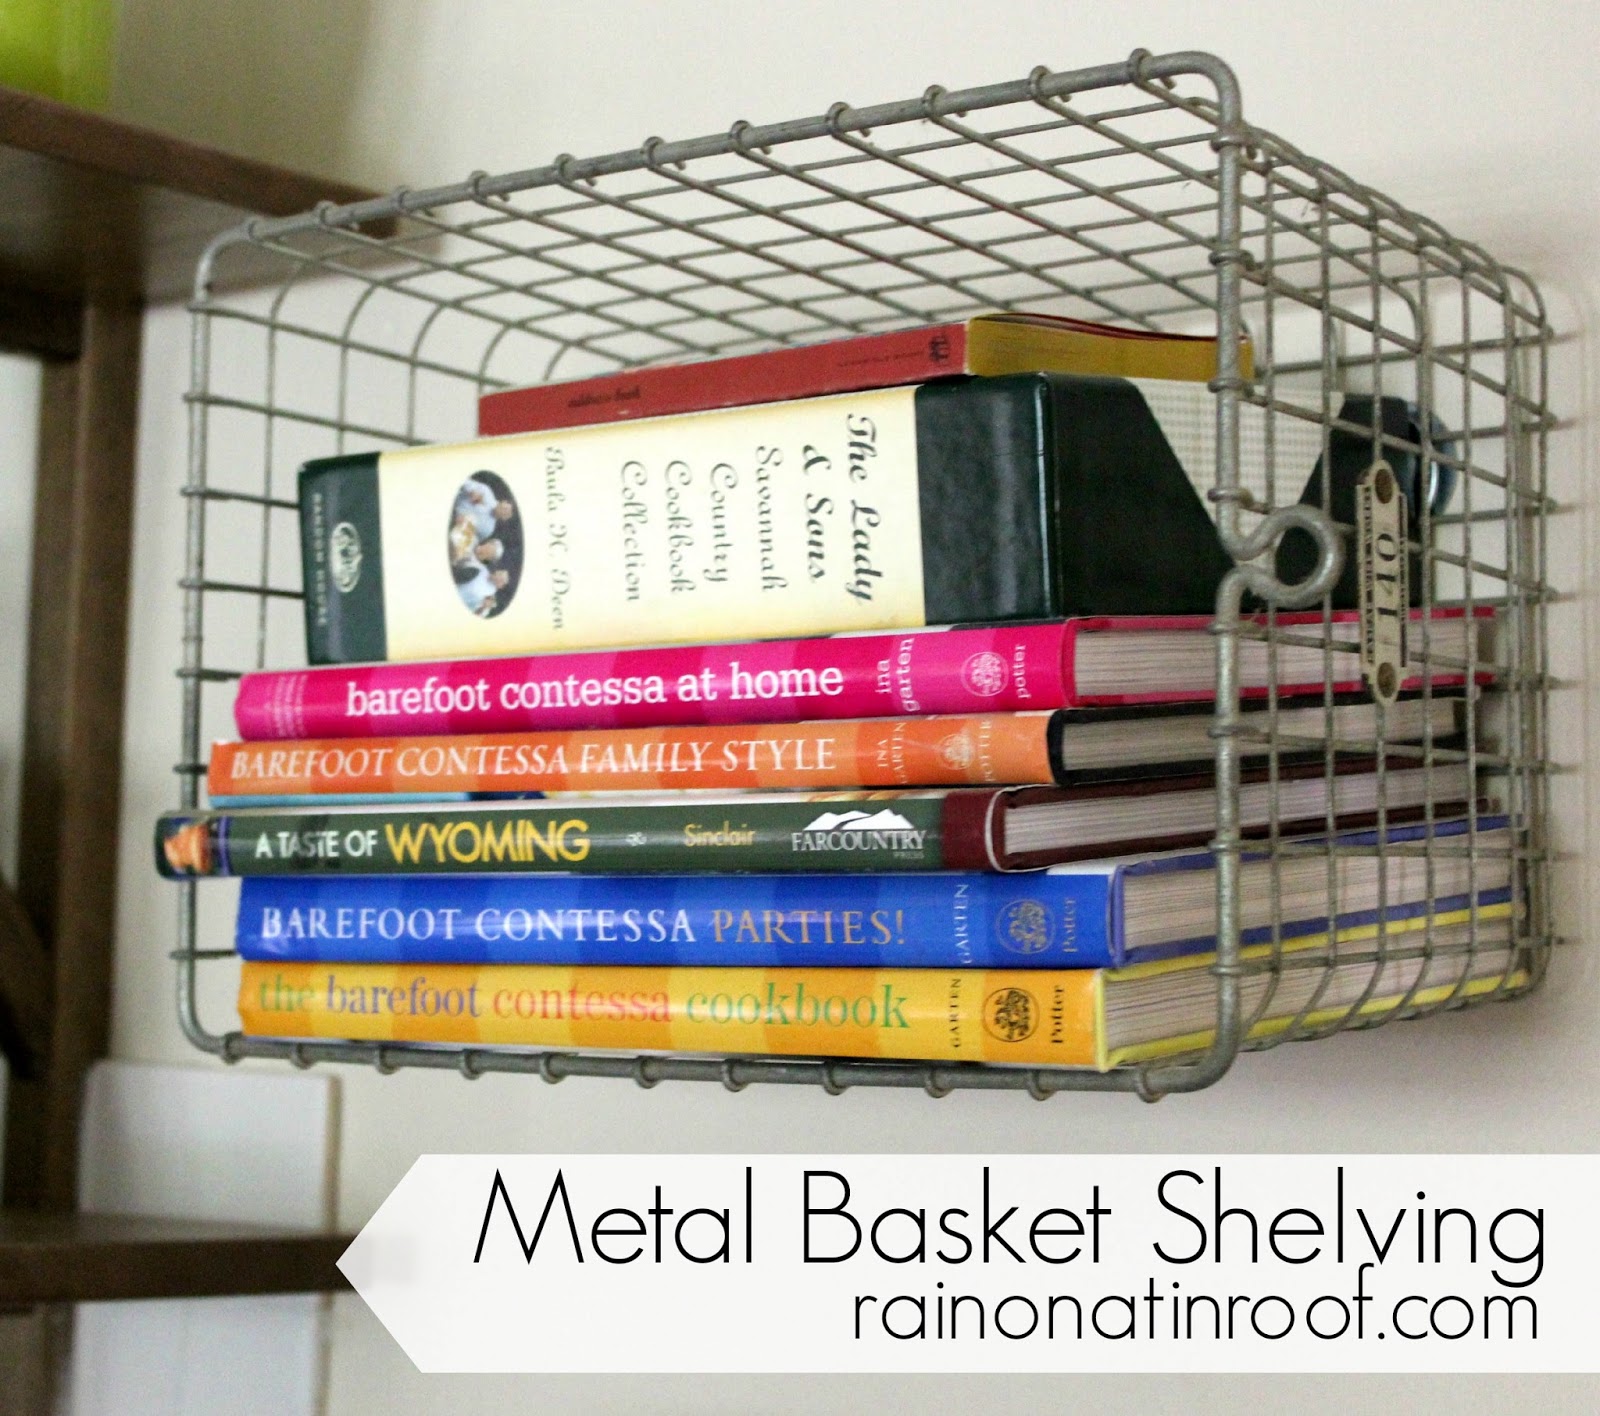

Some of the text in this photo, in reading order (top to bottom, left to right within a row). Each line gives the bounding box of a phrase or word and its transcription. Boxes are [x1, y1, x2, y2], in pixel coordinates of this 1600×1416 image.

[545, 446, 566, 513] Paula
[846, 413, 883, 604] The Lady
[621, 460, 648, 601] Collection
[665, 459, 696, 595] Cookbook
[703, 463, 738, 583] Country
[755, 445, 788, 592] Savannah
[801, 444, 835, 583] & Sons
[551, 567, 572, 630] Deen
[345, 676, 492, 717] barefoot
[500, 670, 668, 710] contessa
[677, 667, 717, 701] at
[729, 662, 844, 700] home
[875, 659, 892, 694] ina
[896, 637, 921, 712] garten
[1012, 644, 1032, 700] potter
[231, 738, 837, 780] BAREFOOT CONTESSA FAMILY STYLE
[877, 738, 889, 768] INA
[255, 819, 592, 864] A TASTE OF WYOMING
[683, 820, 757, 847] Sinclair
[791, 829, 928, 852] FARCOUNTRY
[261, 907, 906, 945] BAREFOOT CONTESSA PARTIES!
[953, 883, 974, 965] GARTEN
[1063, 896, 1079, 953] Potter
[258, 973, 910, 1029] the barefoot contessa cookbook
[949, 977, 963, 1049] GARTEN
[1049, 984, 1066, 1045] Potter
